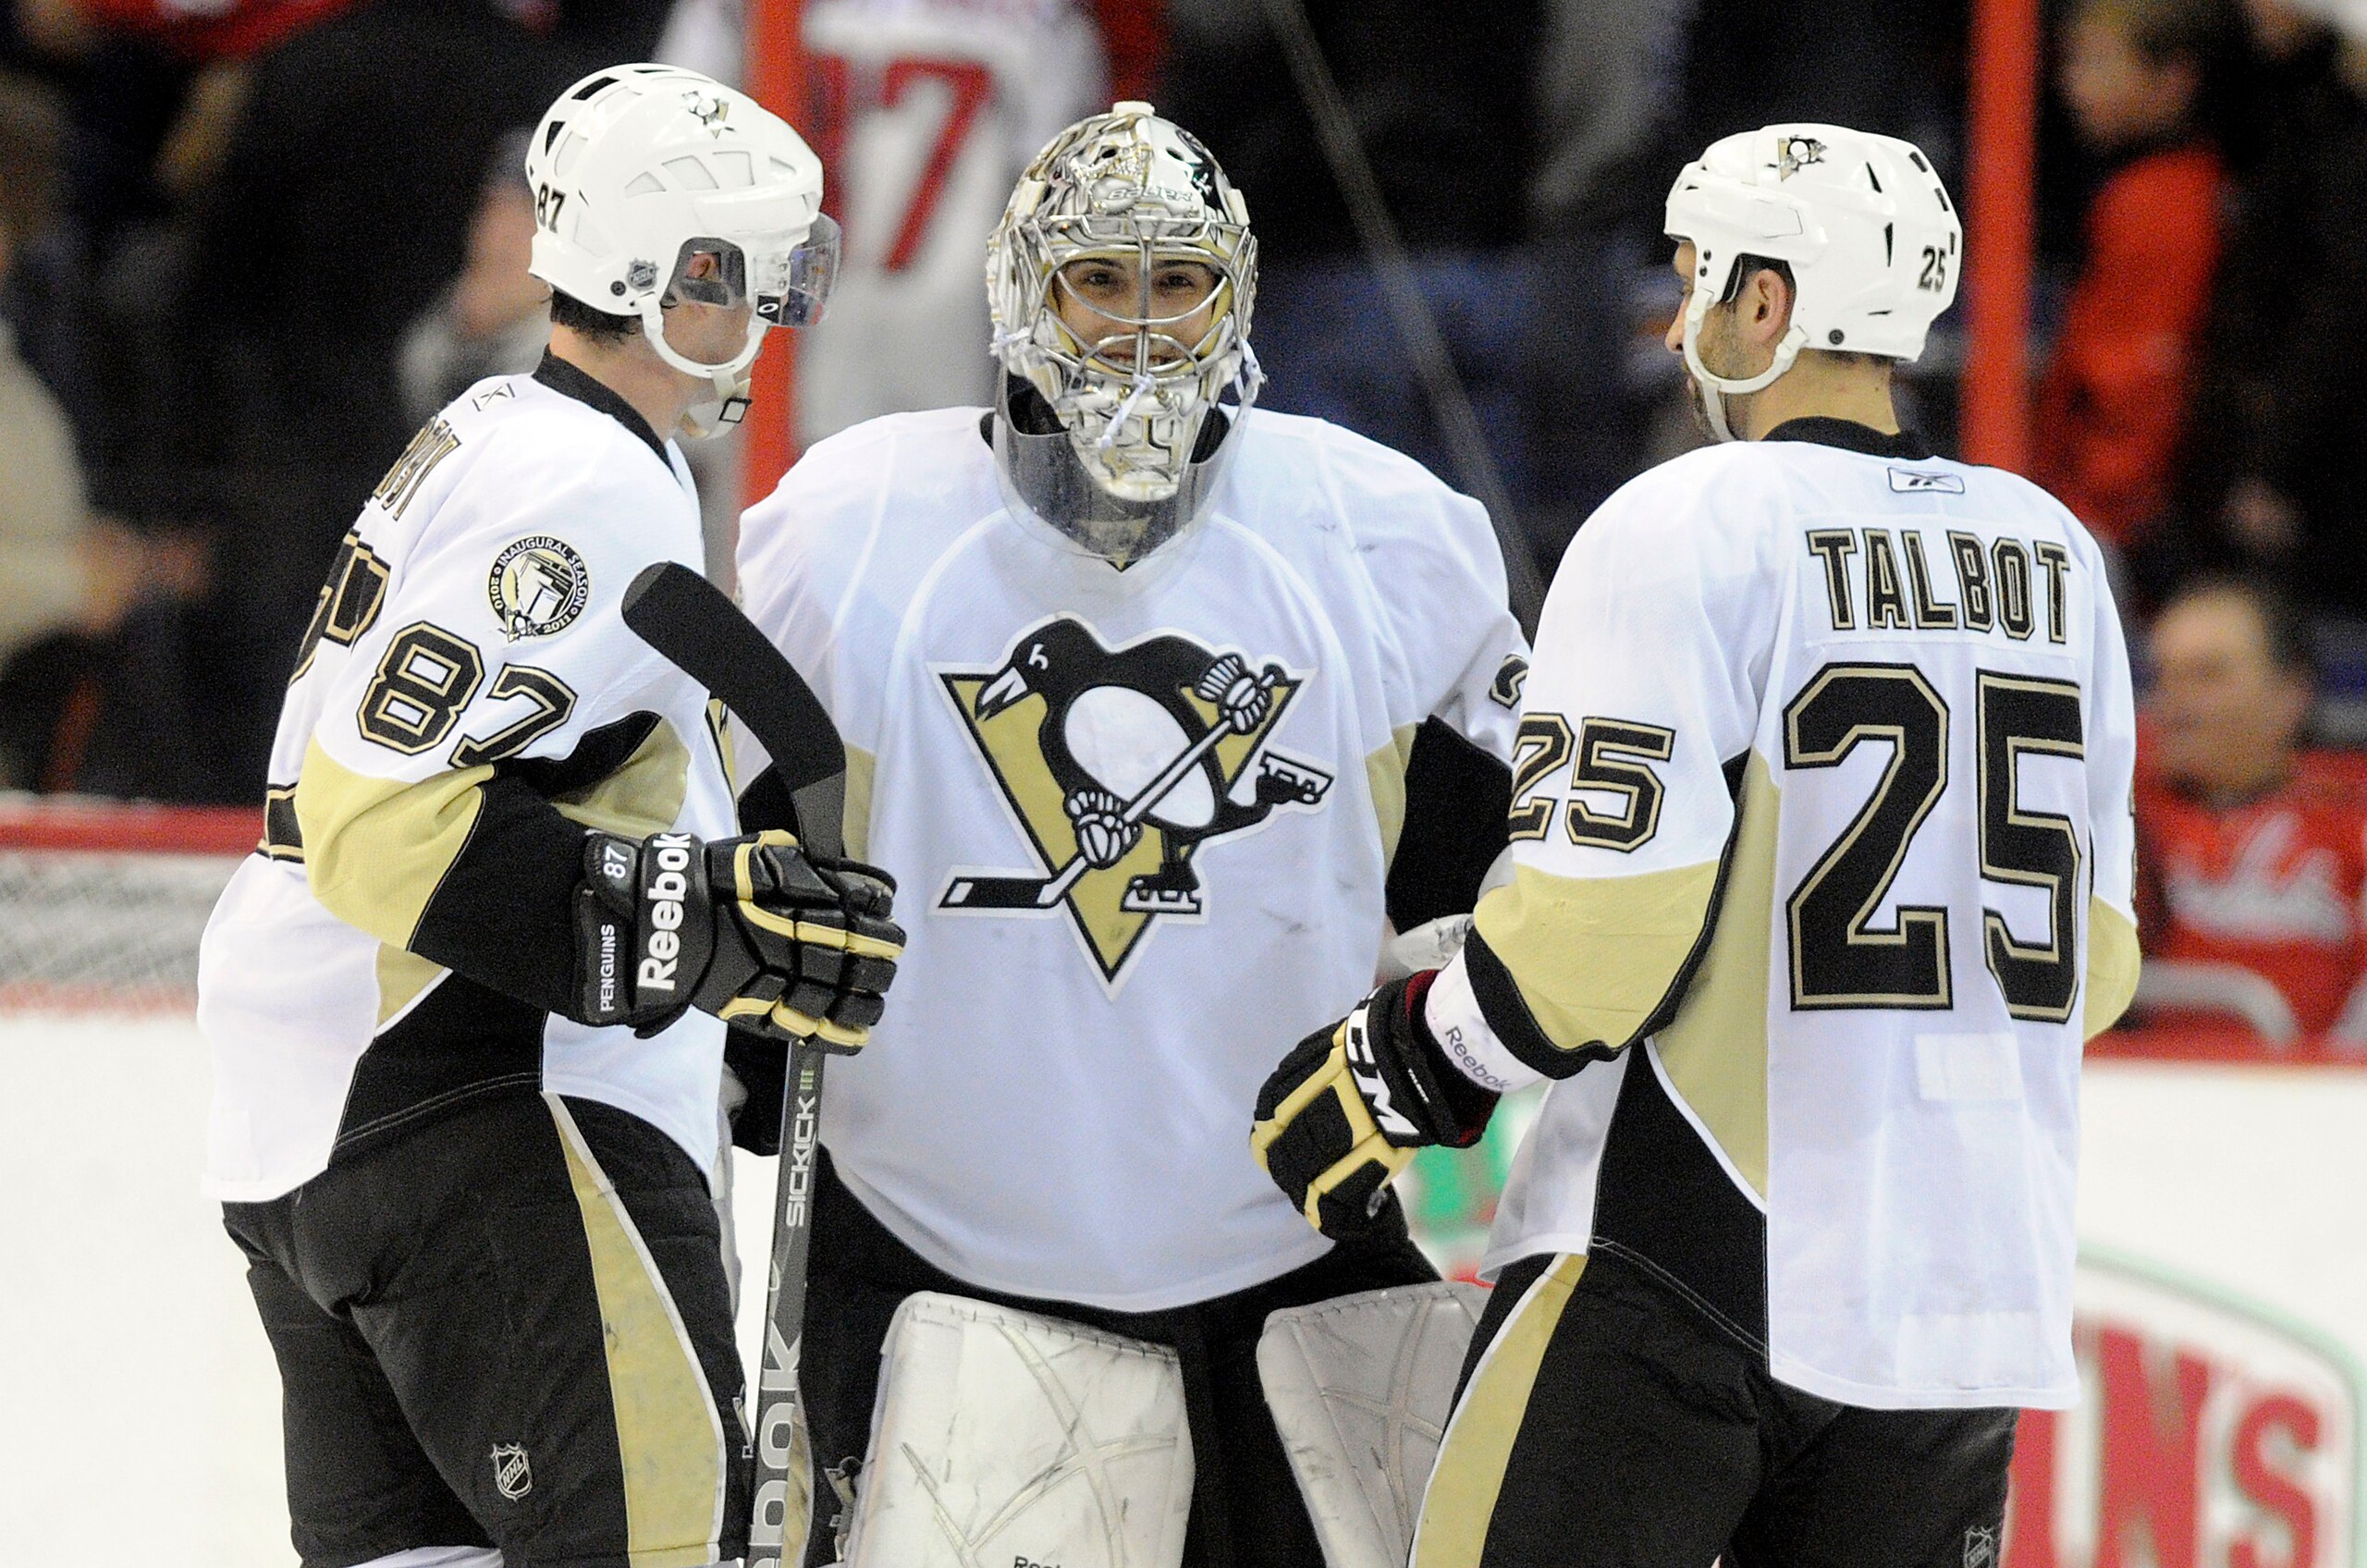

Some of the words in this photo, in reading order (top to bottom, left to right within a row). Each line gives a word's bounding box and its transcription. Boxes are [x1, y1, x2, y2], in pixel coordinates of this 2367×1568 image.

[537, 182, 566, 233] 87
[1917, 245, 1946, 293] 25
[490, 576, 504, 609] 2010
[497, 537, 569, 567] INAUGURAL
[568, 554, 588, 608] SEASON
[1806, 527, 2070, 644] TALBOT
[543, 613, 572, 633] 2011
[357, 620, 578, 768] 87
[1509, 711, 1676, 853] 25
[603, 844, 628, 879] 87
[1783, 661, 2085, 1024] 25
[637, 832, 693, 990] Reebok
[600, 924, 617, 1012] PENGUINS
[1347, 986, 1420, 1134] CM
[1444, 1025, 1513, 1090] Reebok
[786, 1095, 816, 1228] SICKICK
[501, 1457, 525, 1488] NHL
